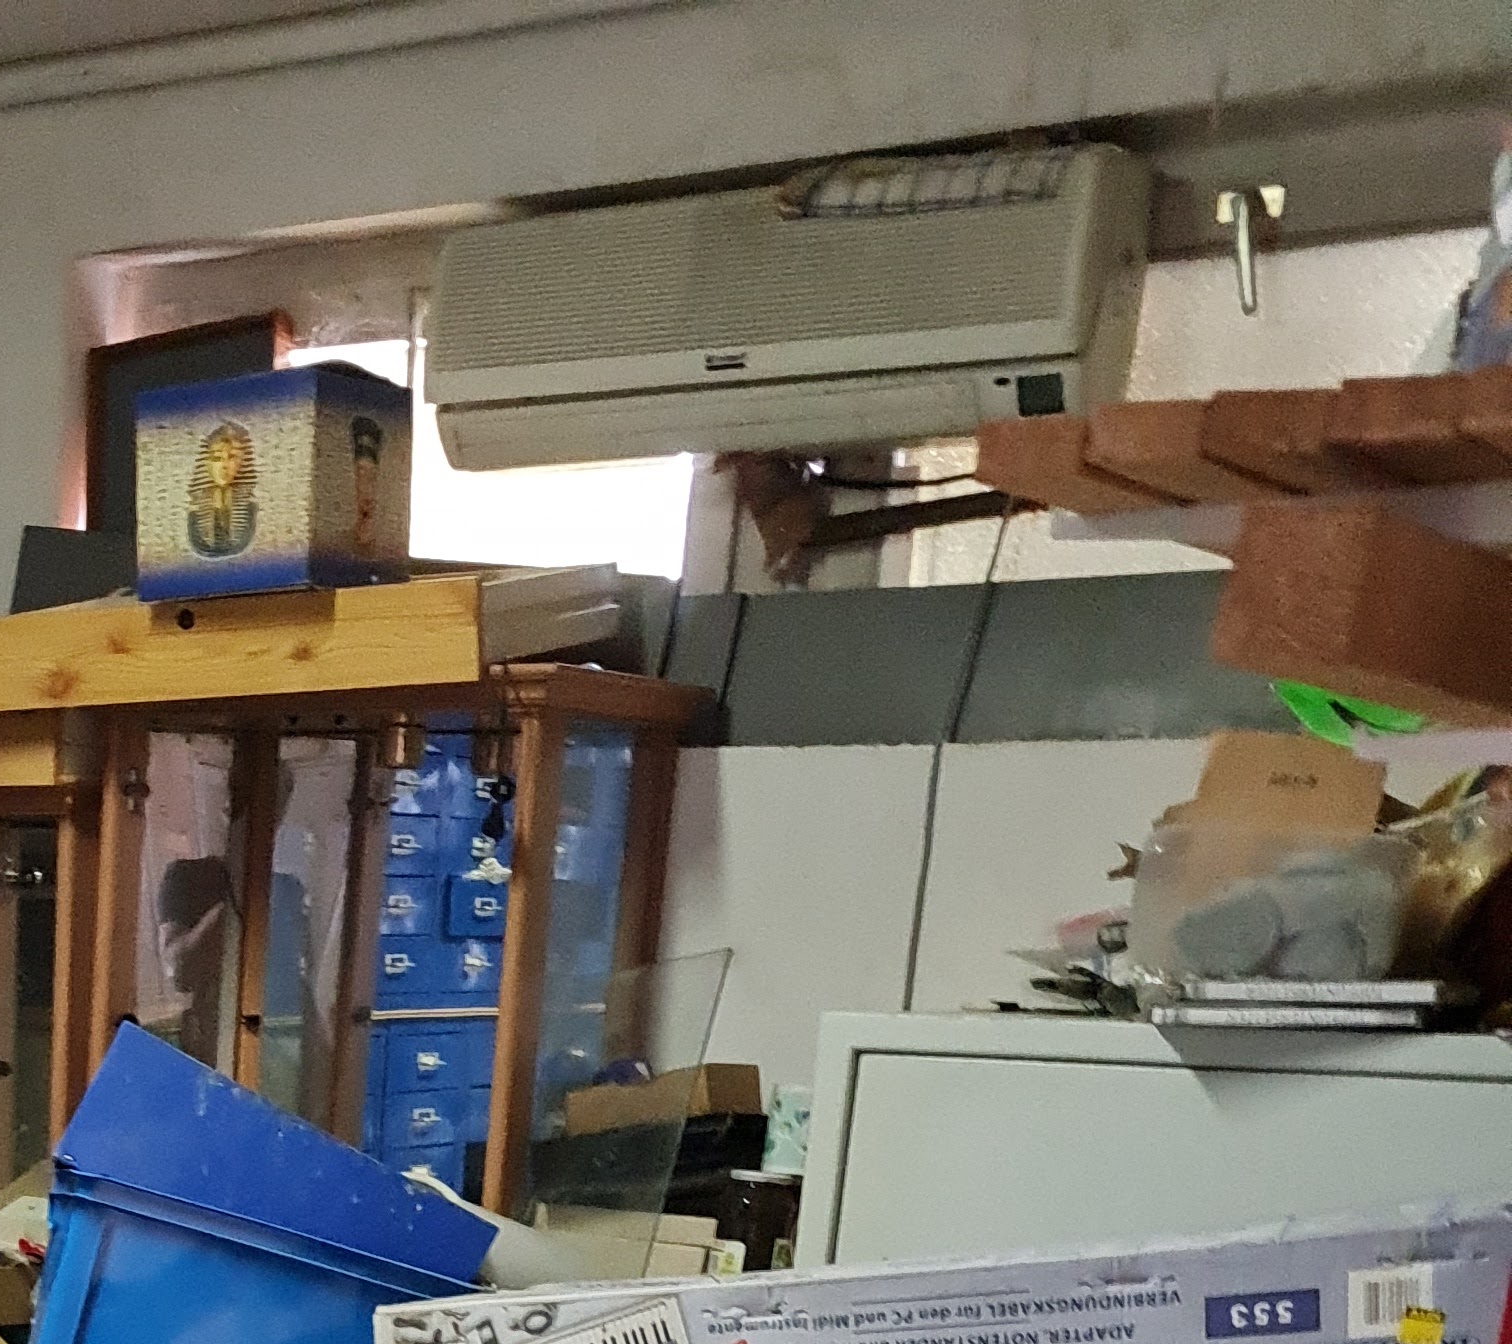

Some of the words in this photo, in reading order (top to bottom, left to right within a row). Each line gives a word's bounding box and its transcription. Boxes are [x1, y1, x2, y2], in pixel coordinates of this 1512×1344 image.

[855, 1312, 887, 1327] und
[892, 1310, 914, 1325] PC
[919, 1306, 951, 1321] den
[1230, 1299, 1294, 1329] 553
